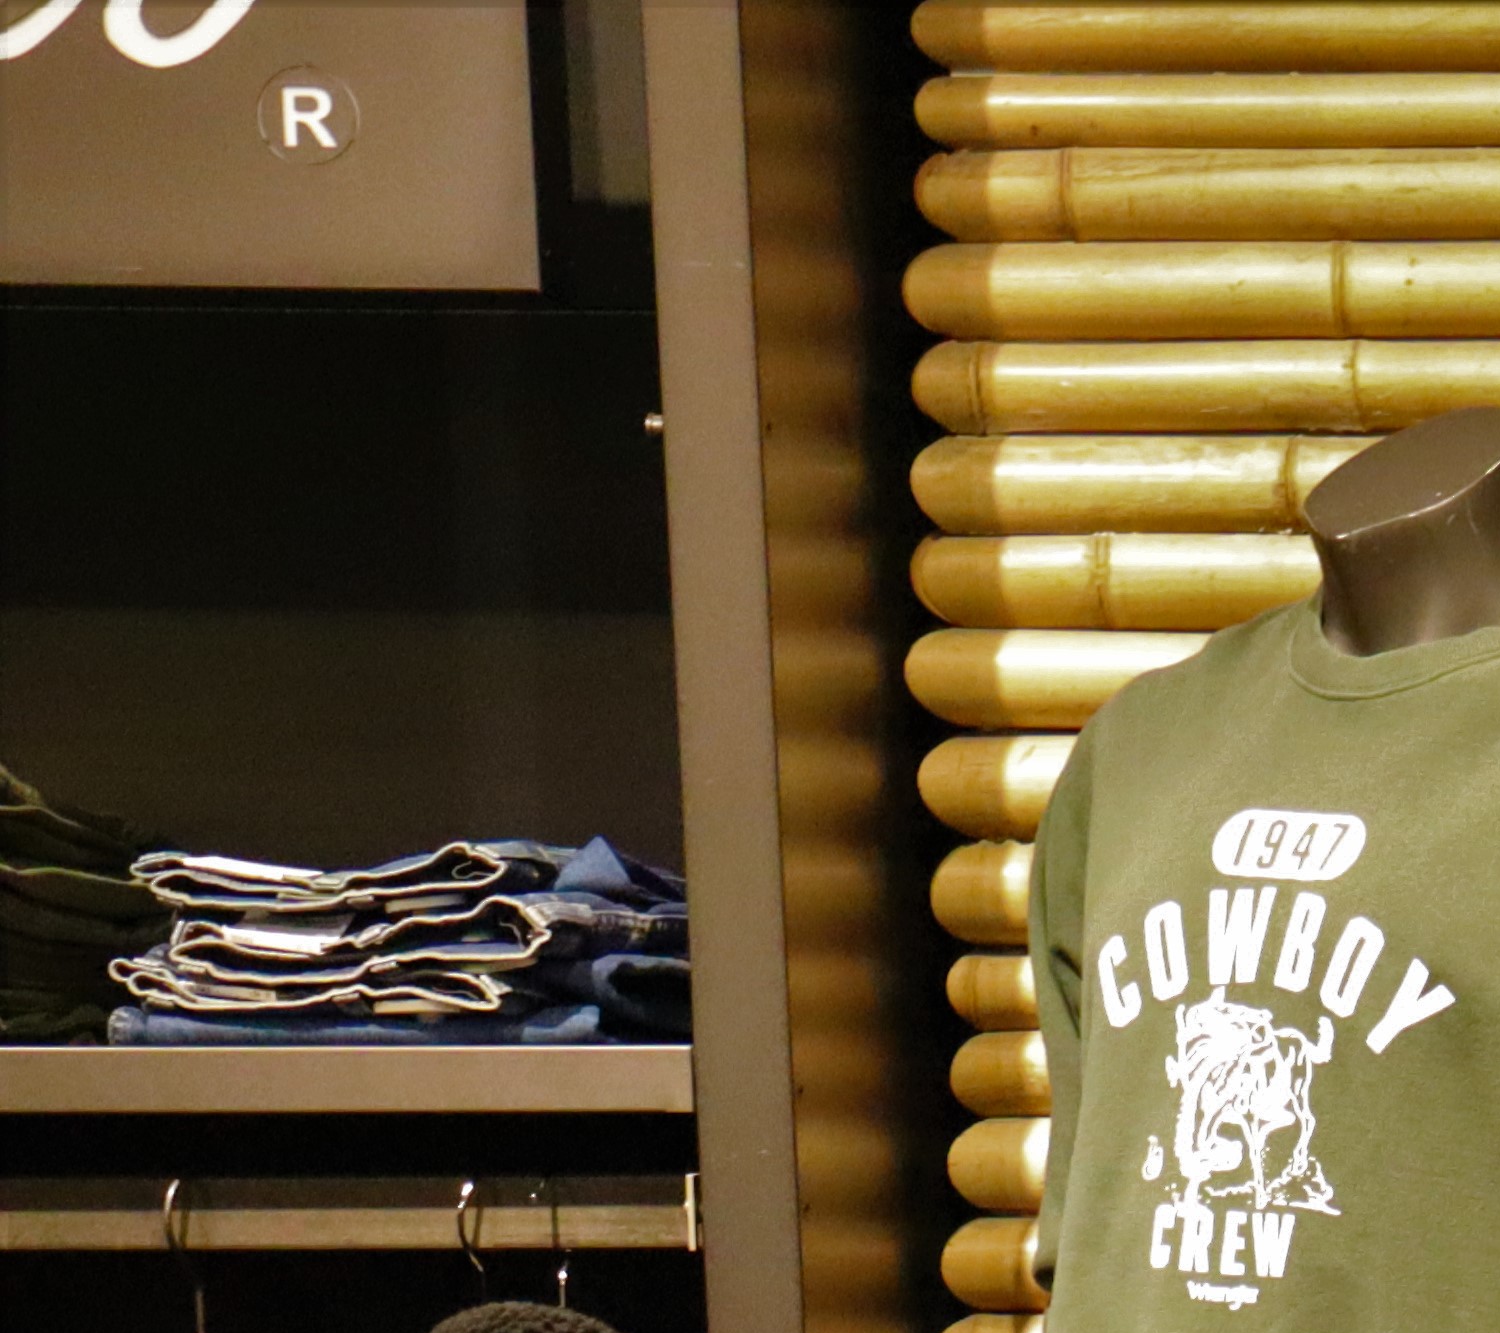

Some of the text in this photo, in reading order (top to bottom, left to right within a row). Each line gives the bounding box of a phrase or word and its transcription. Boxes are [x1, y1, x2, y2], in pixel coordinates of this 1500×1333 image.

[1232, 818, 1350, 872] 1947
[1097, 886, 1456, 1055] COWBOY
[1150, 1202, 1296, 1278] CREW
